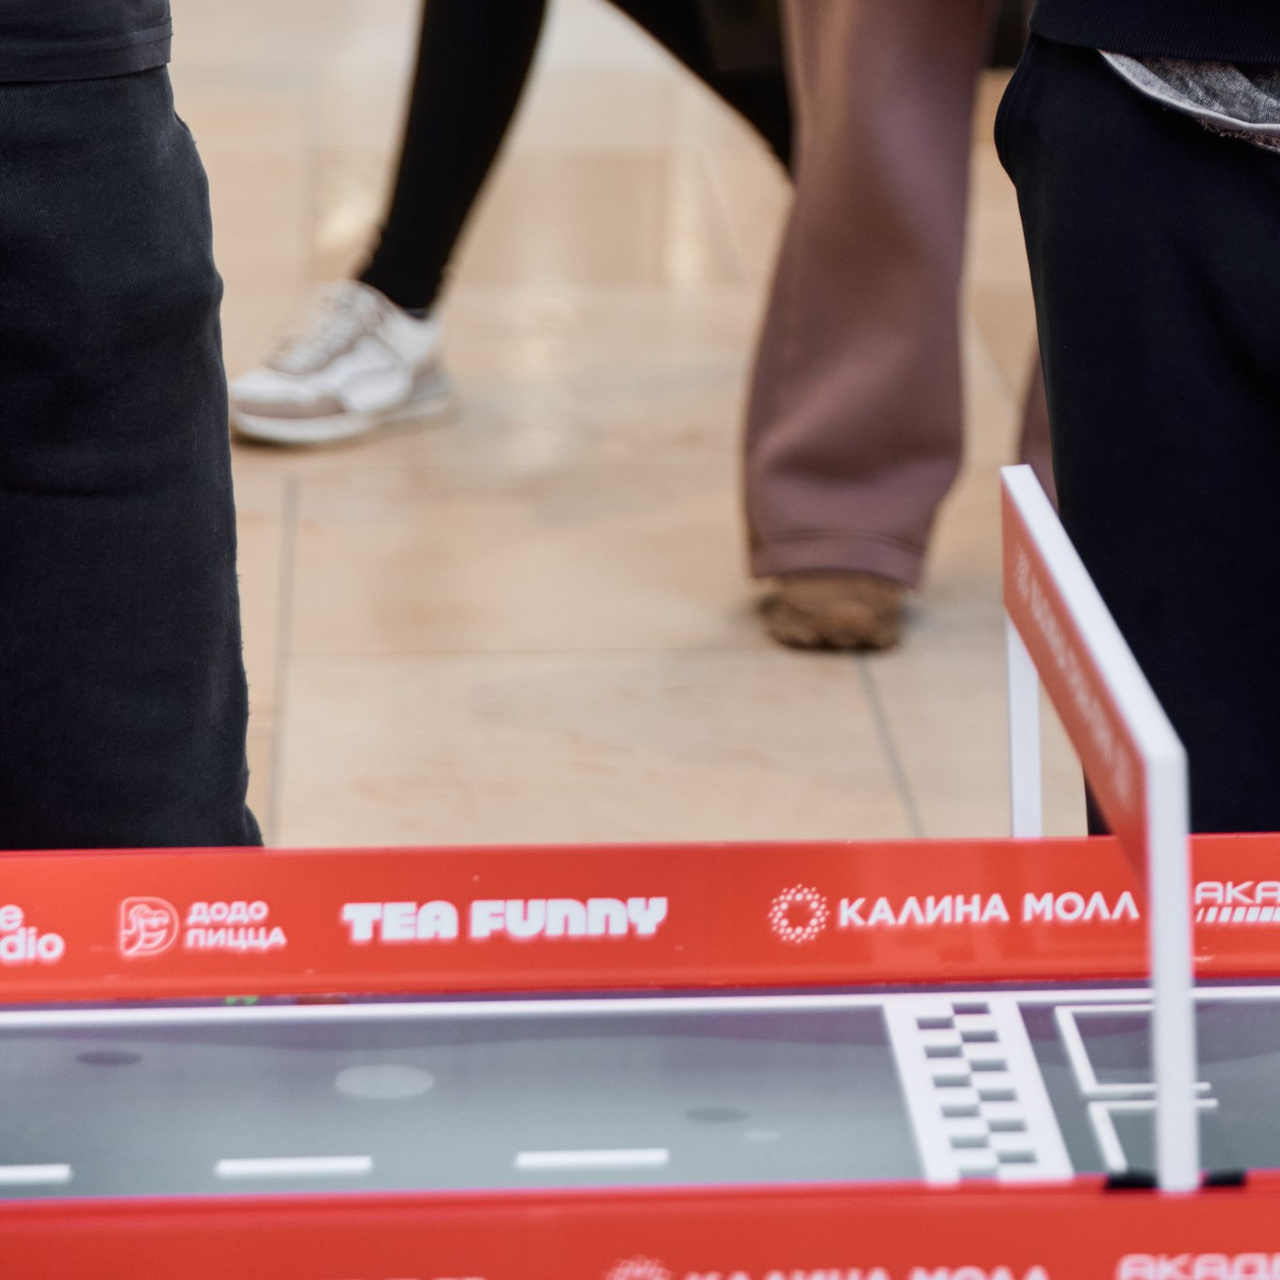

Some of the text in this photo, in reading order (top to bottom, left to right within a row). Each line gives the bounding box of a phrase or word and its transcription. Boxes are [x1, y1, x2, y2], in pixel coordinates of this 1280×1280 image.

[187, 901, 268, 926] ДОДО
[342, 898, 667, 942] TEA FUNNY
[840, 892, 1139, 927] КАЛИНА МОЛЛ
[186, 926, 286, 951] ПИЦЦА
